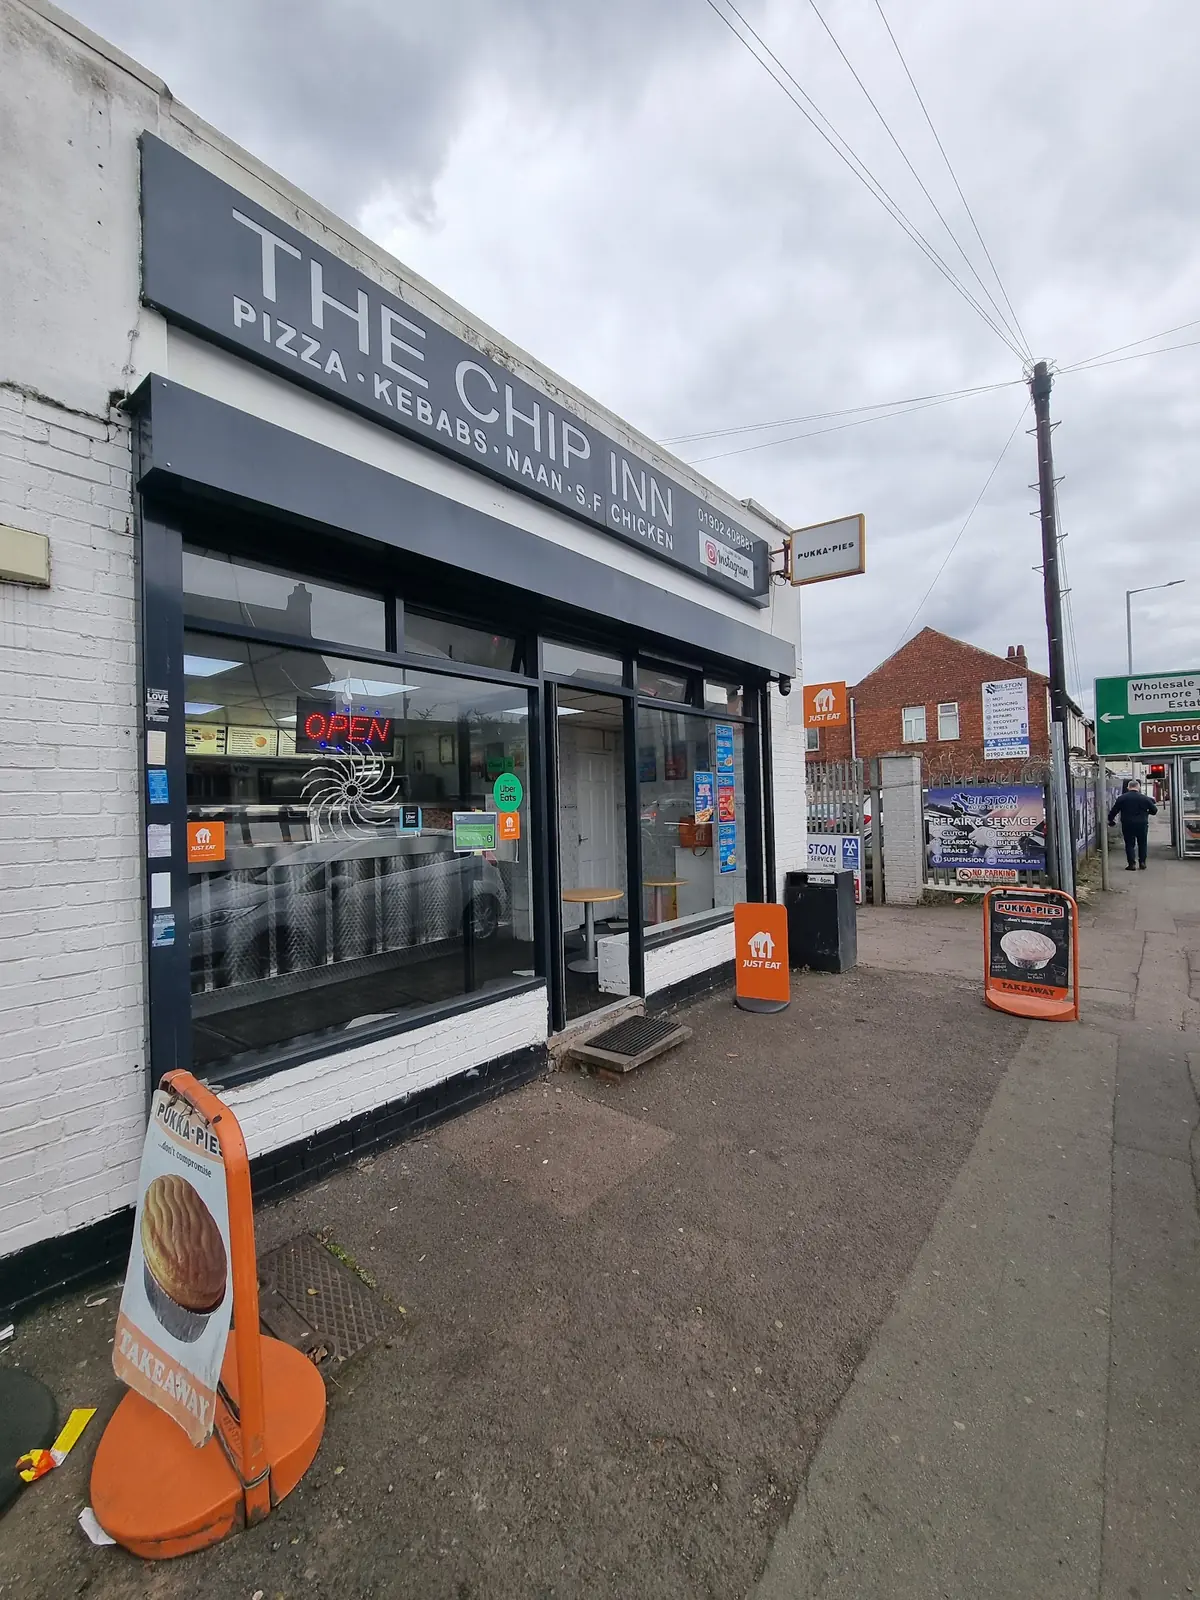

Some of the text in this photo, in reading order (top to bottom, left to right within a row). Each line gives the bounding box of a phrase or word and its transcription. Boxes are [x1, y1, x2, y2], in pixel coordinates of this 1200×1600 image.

[232, 207, 673, 527] THE CHIP INN
[233, 295, 674, 551] PIZZA KEBABS NAAN S.F CHICKEN
[698, 508, 725, 535] 01902
[717, 549, 749, 578] Instagram
[1132, 679, 1195, 692] Wholesale
[147, 692, 168, 702] LOVE
[1134, 690, 1192, 701] Monmore
[808, 712, 841, 722] JUST EAT
[304, 712, 390, 742] OPEN
[1146, 724, 1200, 734] Monmore
[500, 784, 516, 792] Uber
[500, 794, 516, 802] Eats
[968, 795, 1018, 805] BILSTON
[933, 817, 1037, 826] REPAIR & SERVICE
[743, 960, 782, 970] JUST EAT
[1001, 982, 1055, 996] TAKEAWAY
[176, 1151, 212, 1178] compromise
[119, 1328, 210, 1426] TAKEAWAY
